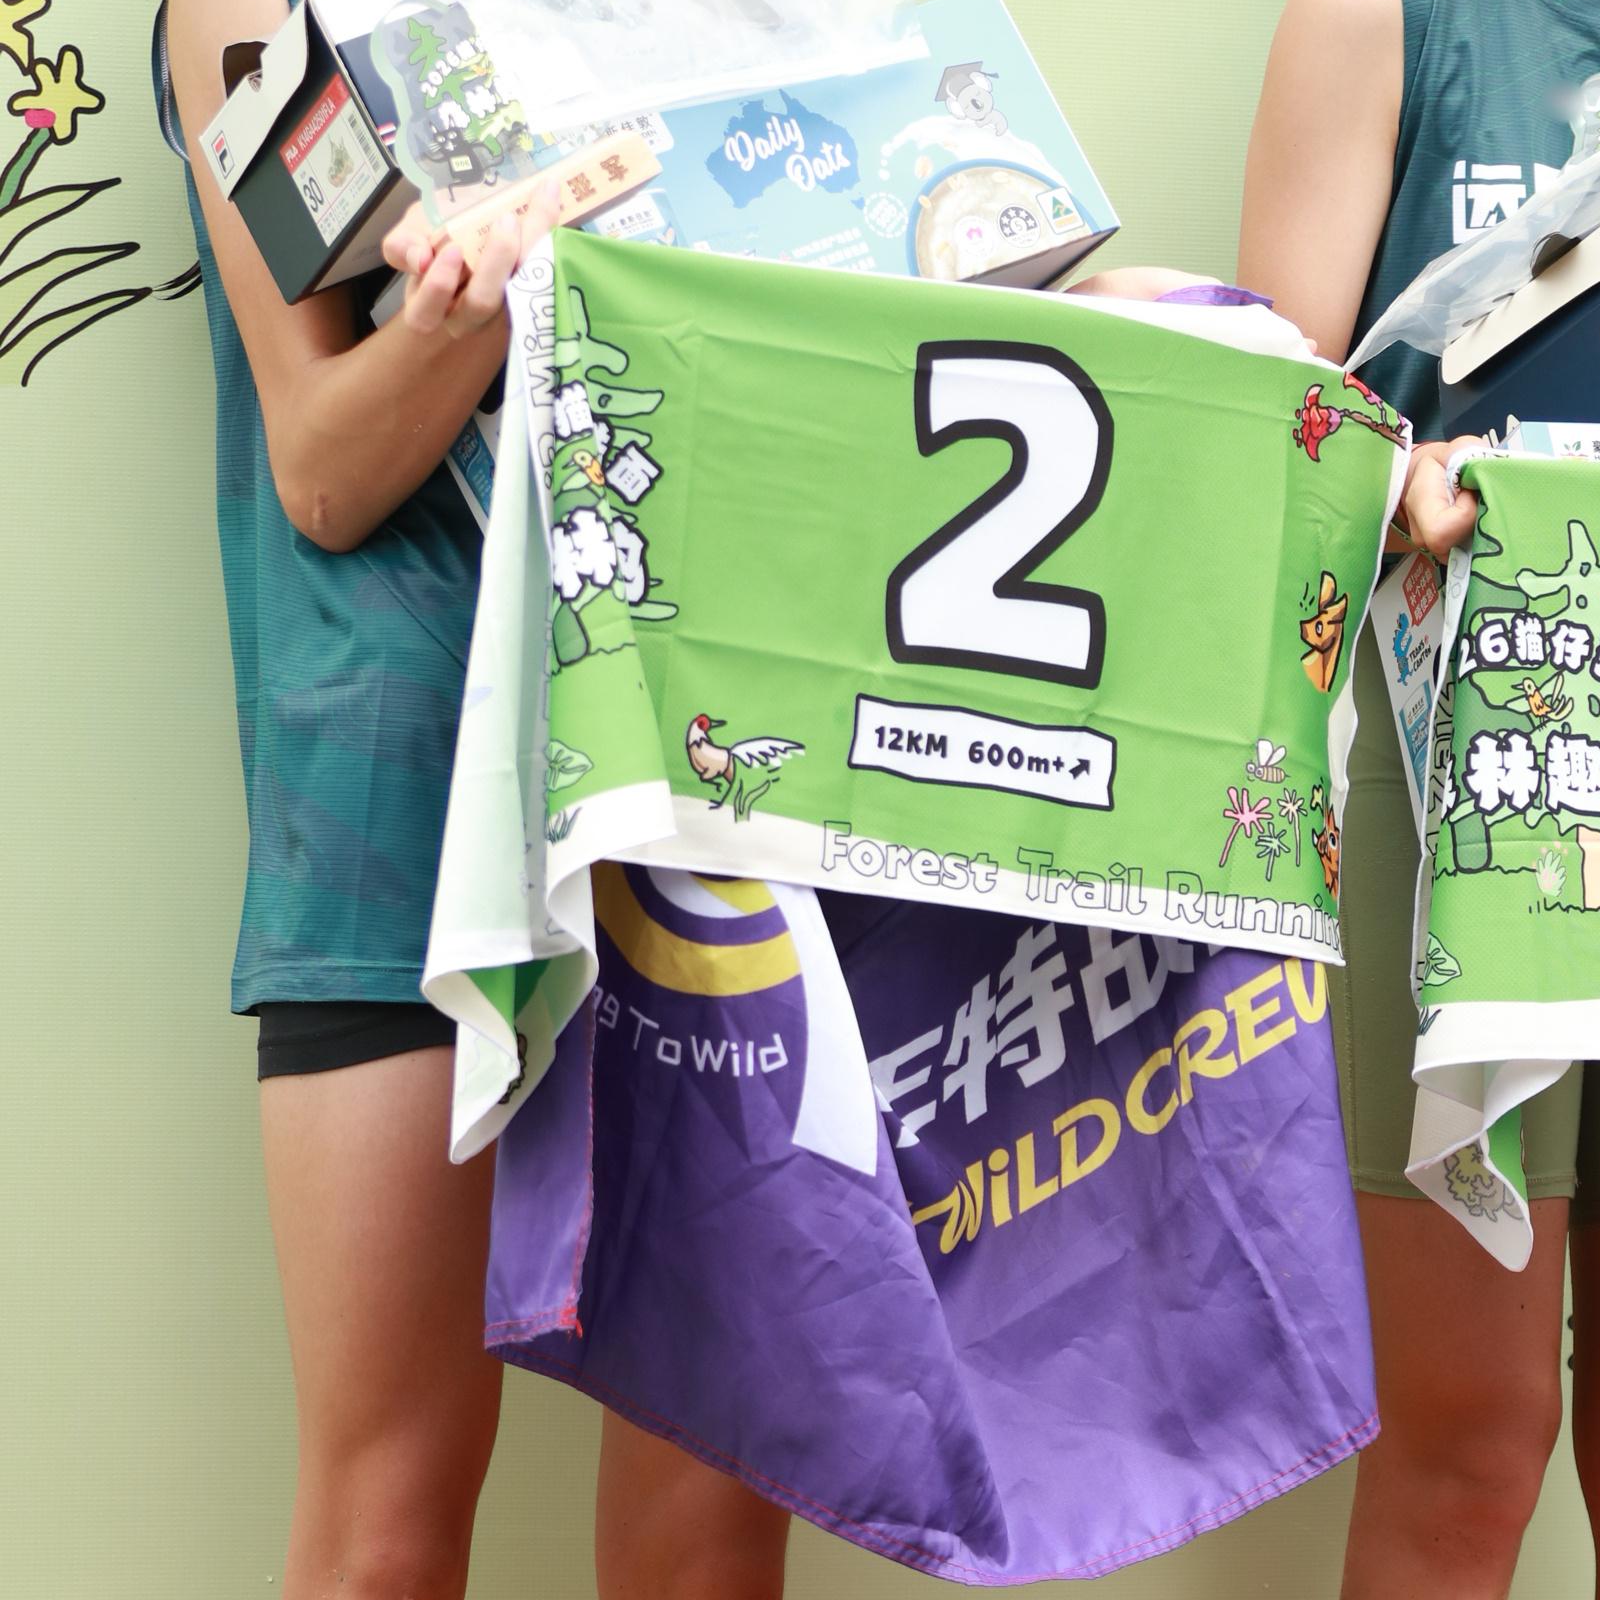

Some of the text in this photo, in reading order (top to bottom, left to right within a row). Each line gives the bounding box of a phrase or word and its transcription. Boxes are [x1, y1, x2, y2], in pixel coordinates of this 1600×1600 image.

[725, 114, 806, 172] Daily
[785, 141, 851, 193] Oats
[303, 177, 325, 213] 30
[886, 340, 1114, 690] 2
[873, 725, 1066, 775] 12KM 600m+
[820, 820, 999, 892] Forest
[1017, 846, 1148, 916] Trail
